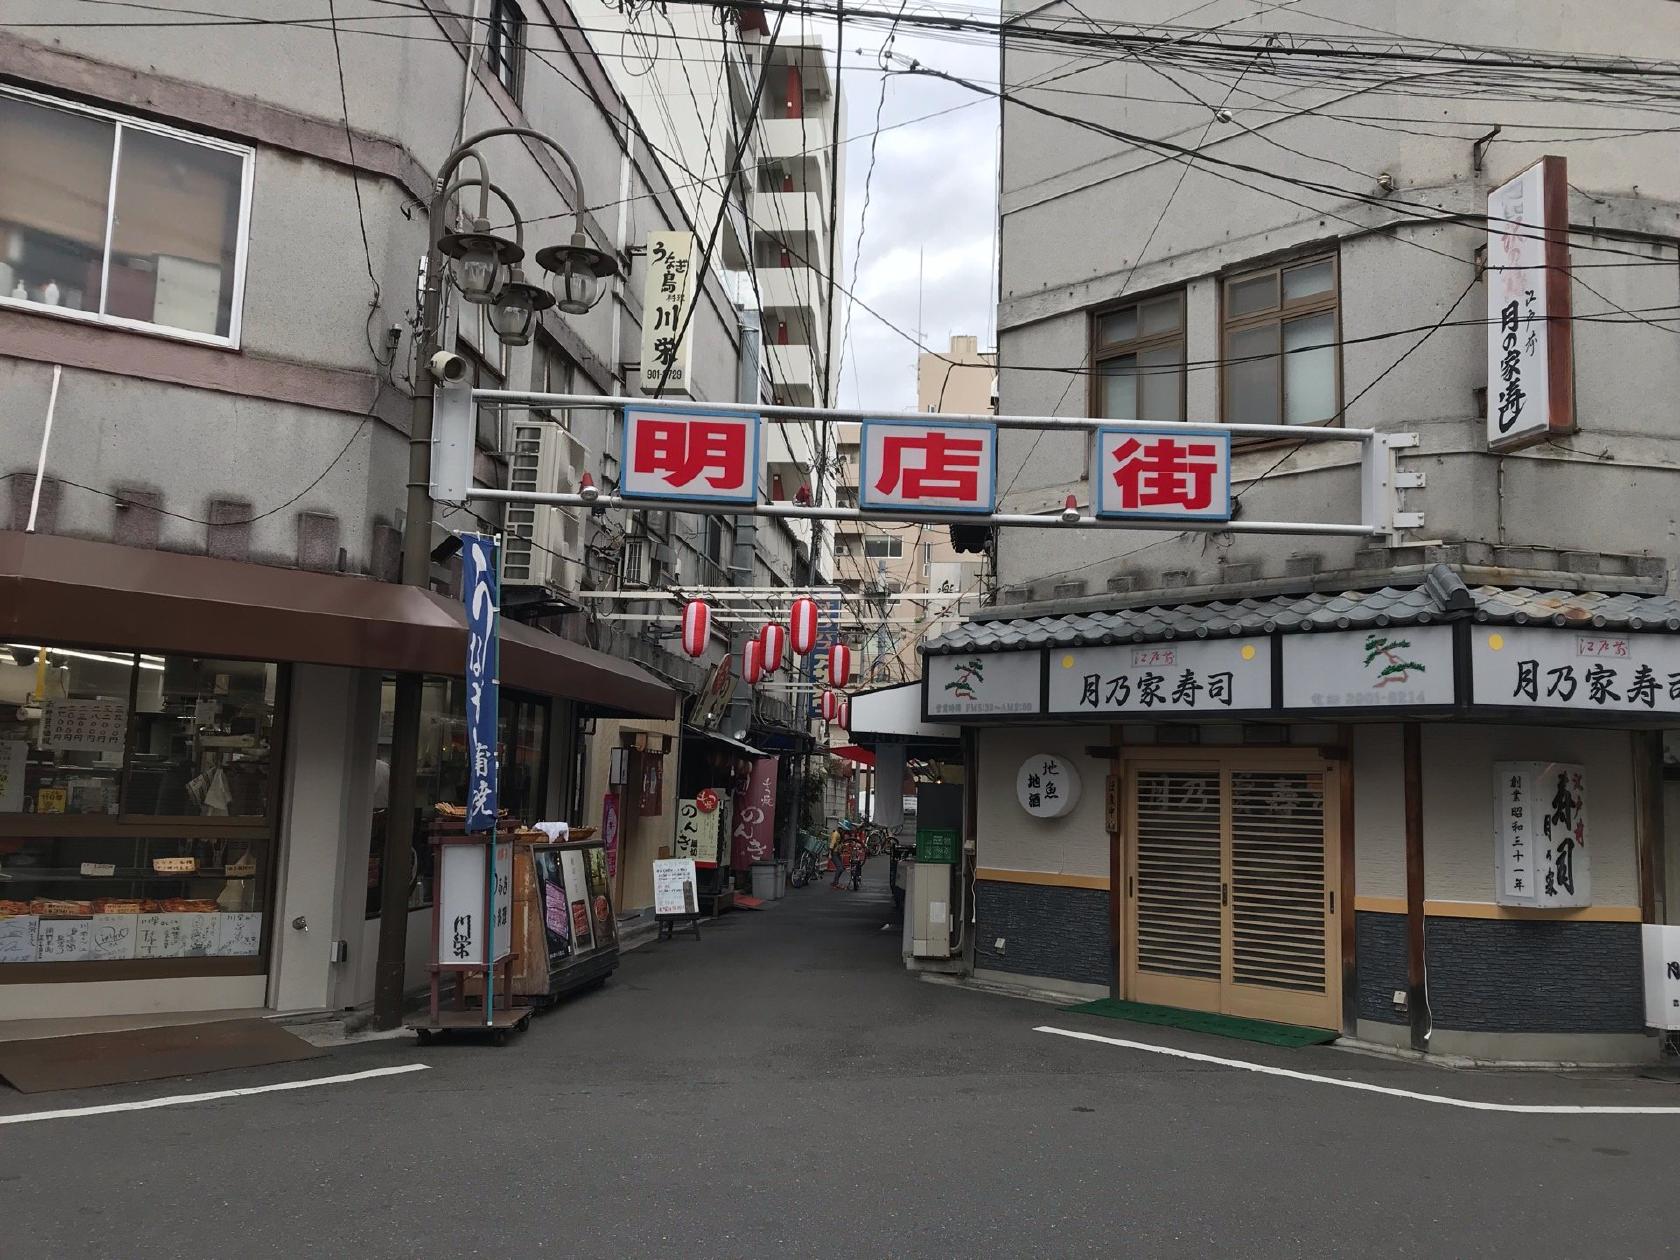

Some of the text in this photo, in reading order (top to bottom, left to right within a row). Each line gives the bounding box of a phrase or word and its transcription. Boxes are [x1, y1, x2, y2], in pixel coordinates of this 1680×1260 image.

[652, 241, 688, 273] うなぎ
[647, 369, 682, 380] 901-729
[1079, 668, 1234, 708] 月乃家寿司
[1027, 773, 1041, 808] 地酒
[1042, 760, 1060, 799] 地魚
[734, 806, 767, 862] のんき
[1509, 775, 1525, 893] 創業昭和三十一年
[452, 914, 472, 960] 川栄
